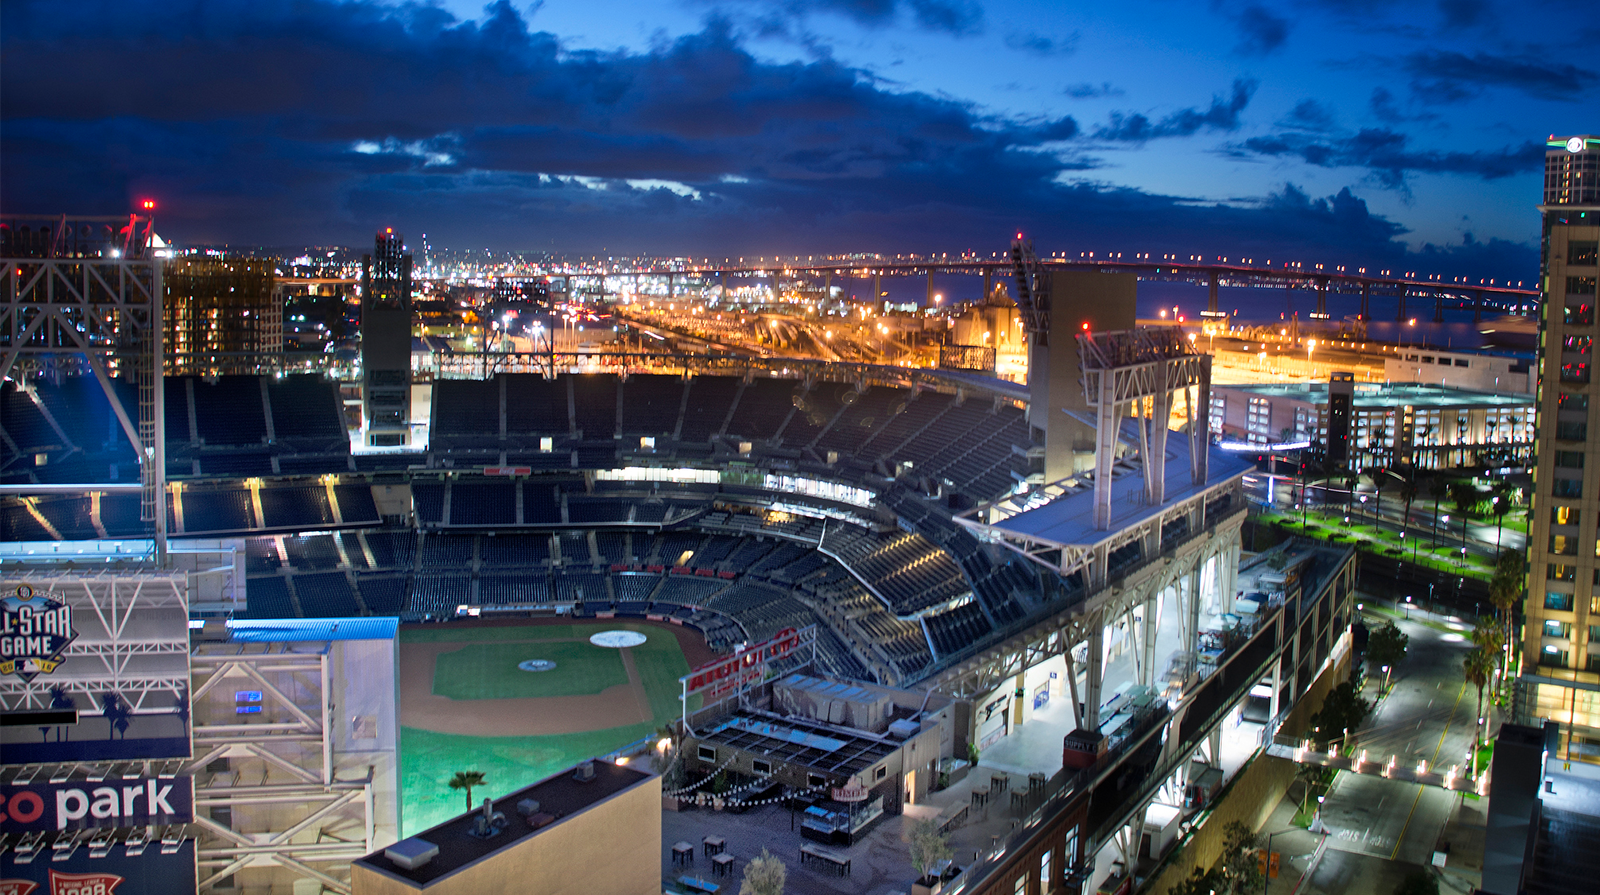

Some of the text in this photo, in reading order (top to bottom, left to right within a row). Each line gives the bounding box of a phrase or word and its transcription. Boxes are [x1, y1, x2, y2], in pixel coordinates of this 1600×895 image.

[0, 605, 71, 639] L STAR
[1, 636, 53, 656] GAME
[1065, 738, 1090, 750] SUPPLY
[56, 779, 175, 830] park
